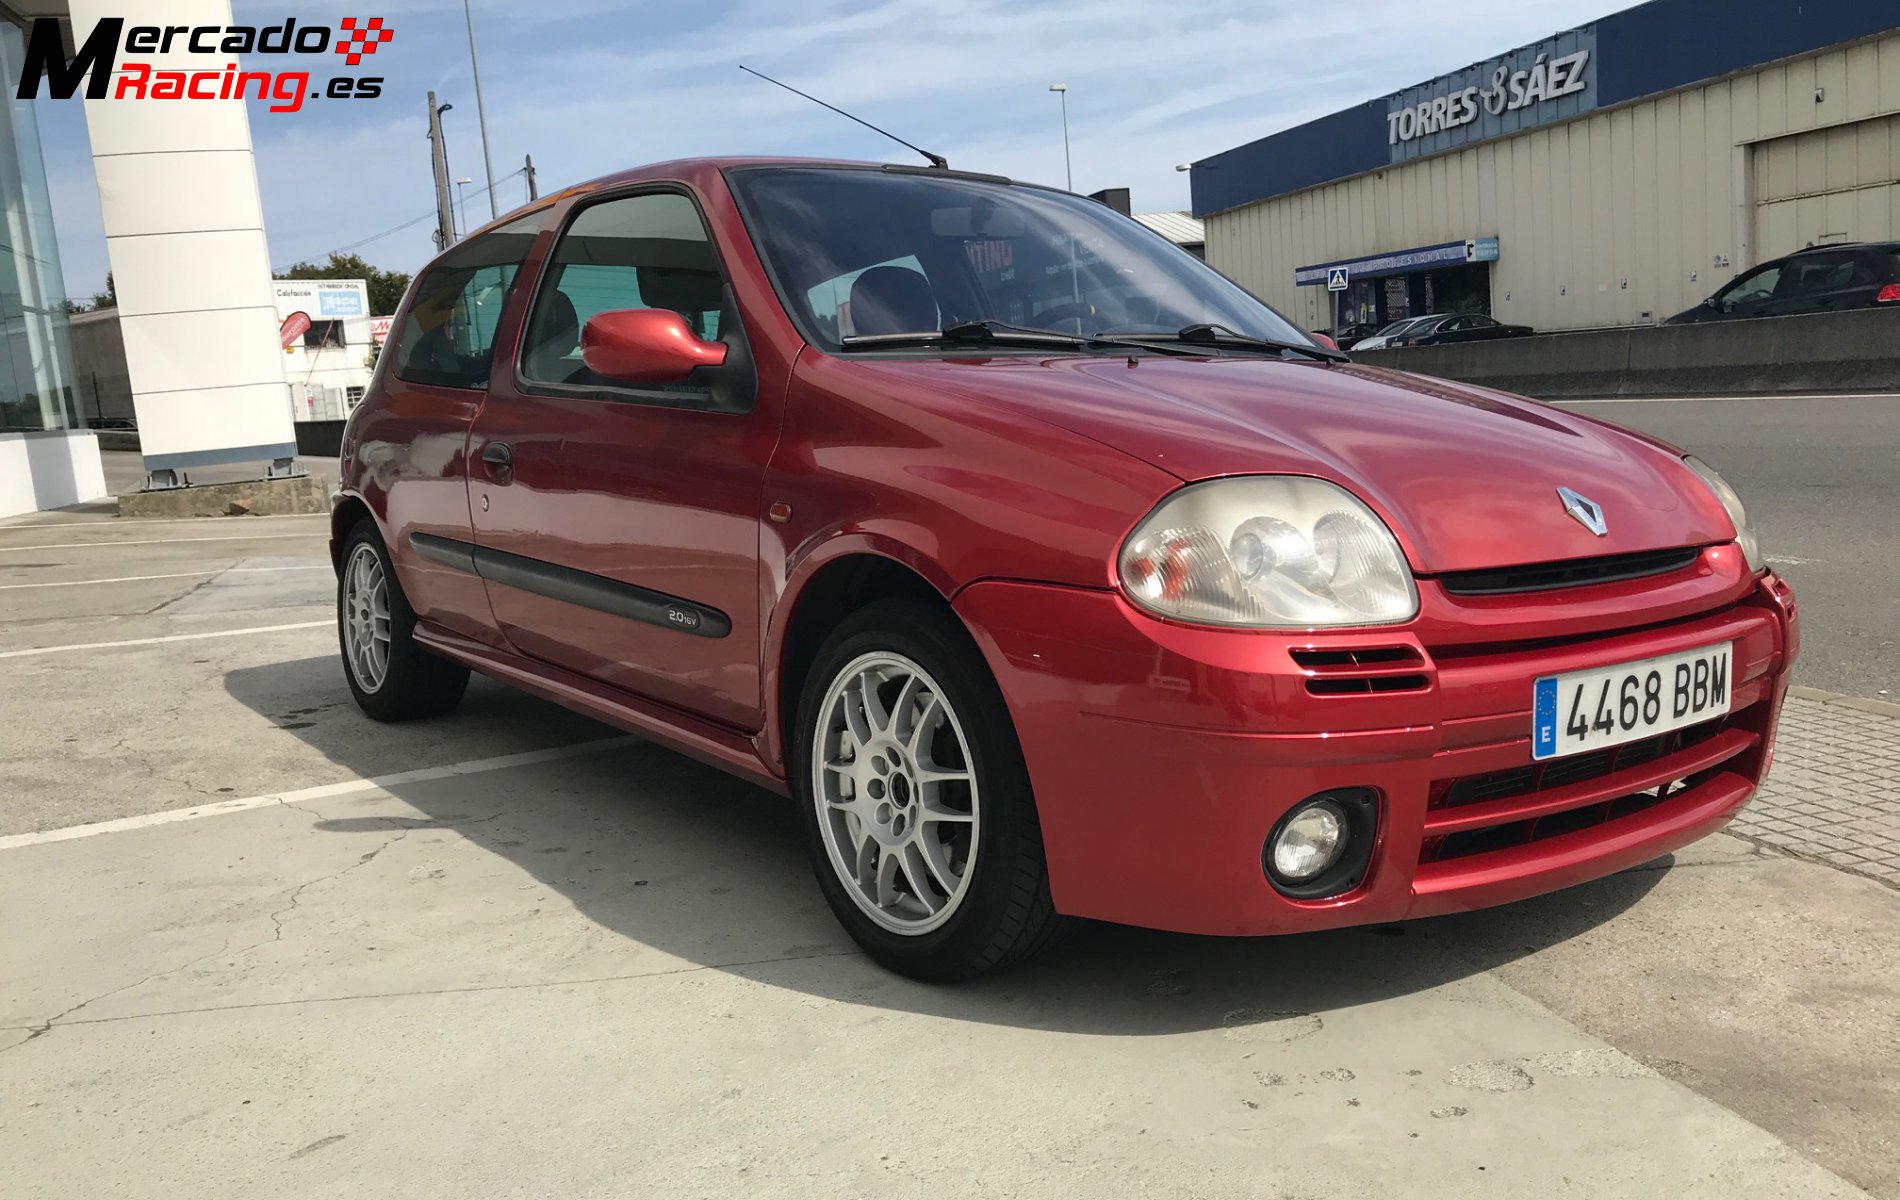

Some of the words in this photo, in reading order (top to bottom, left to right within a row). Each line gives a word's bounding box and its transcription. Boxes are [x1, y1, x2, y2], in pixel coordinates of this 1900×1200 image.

[1387, 86, 1479, 145] TORRES
[1507, 50, 1590, 111] SÁEZ
[1373, 248, 1449, 269] PROFESIONAL
[1566, 670, 1662, 741] 4468
[1673, 653, 1727, 719] BBM
[1541, 726, 1551, 743] E
